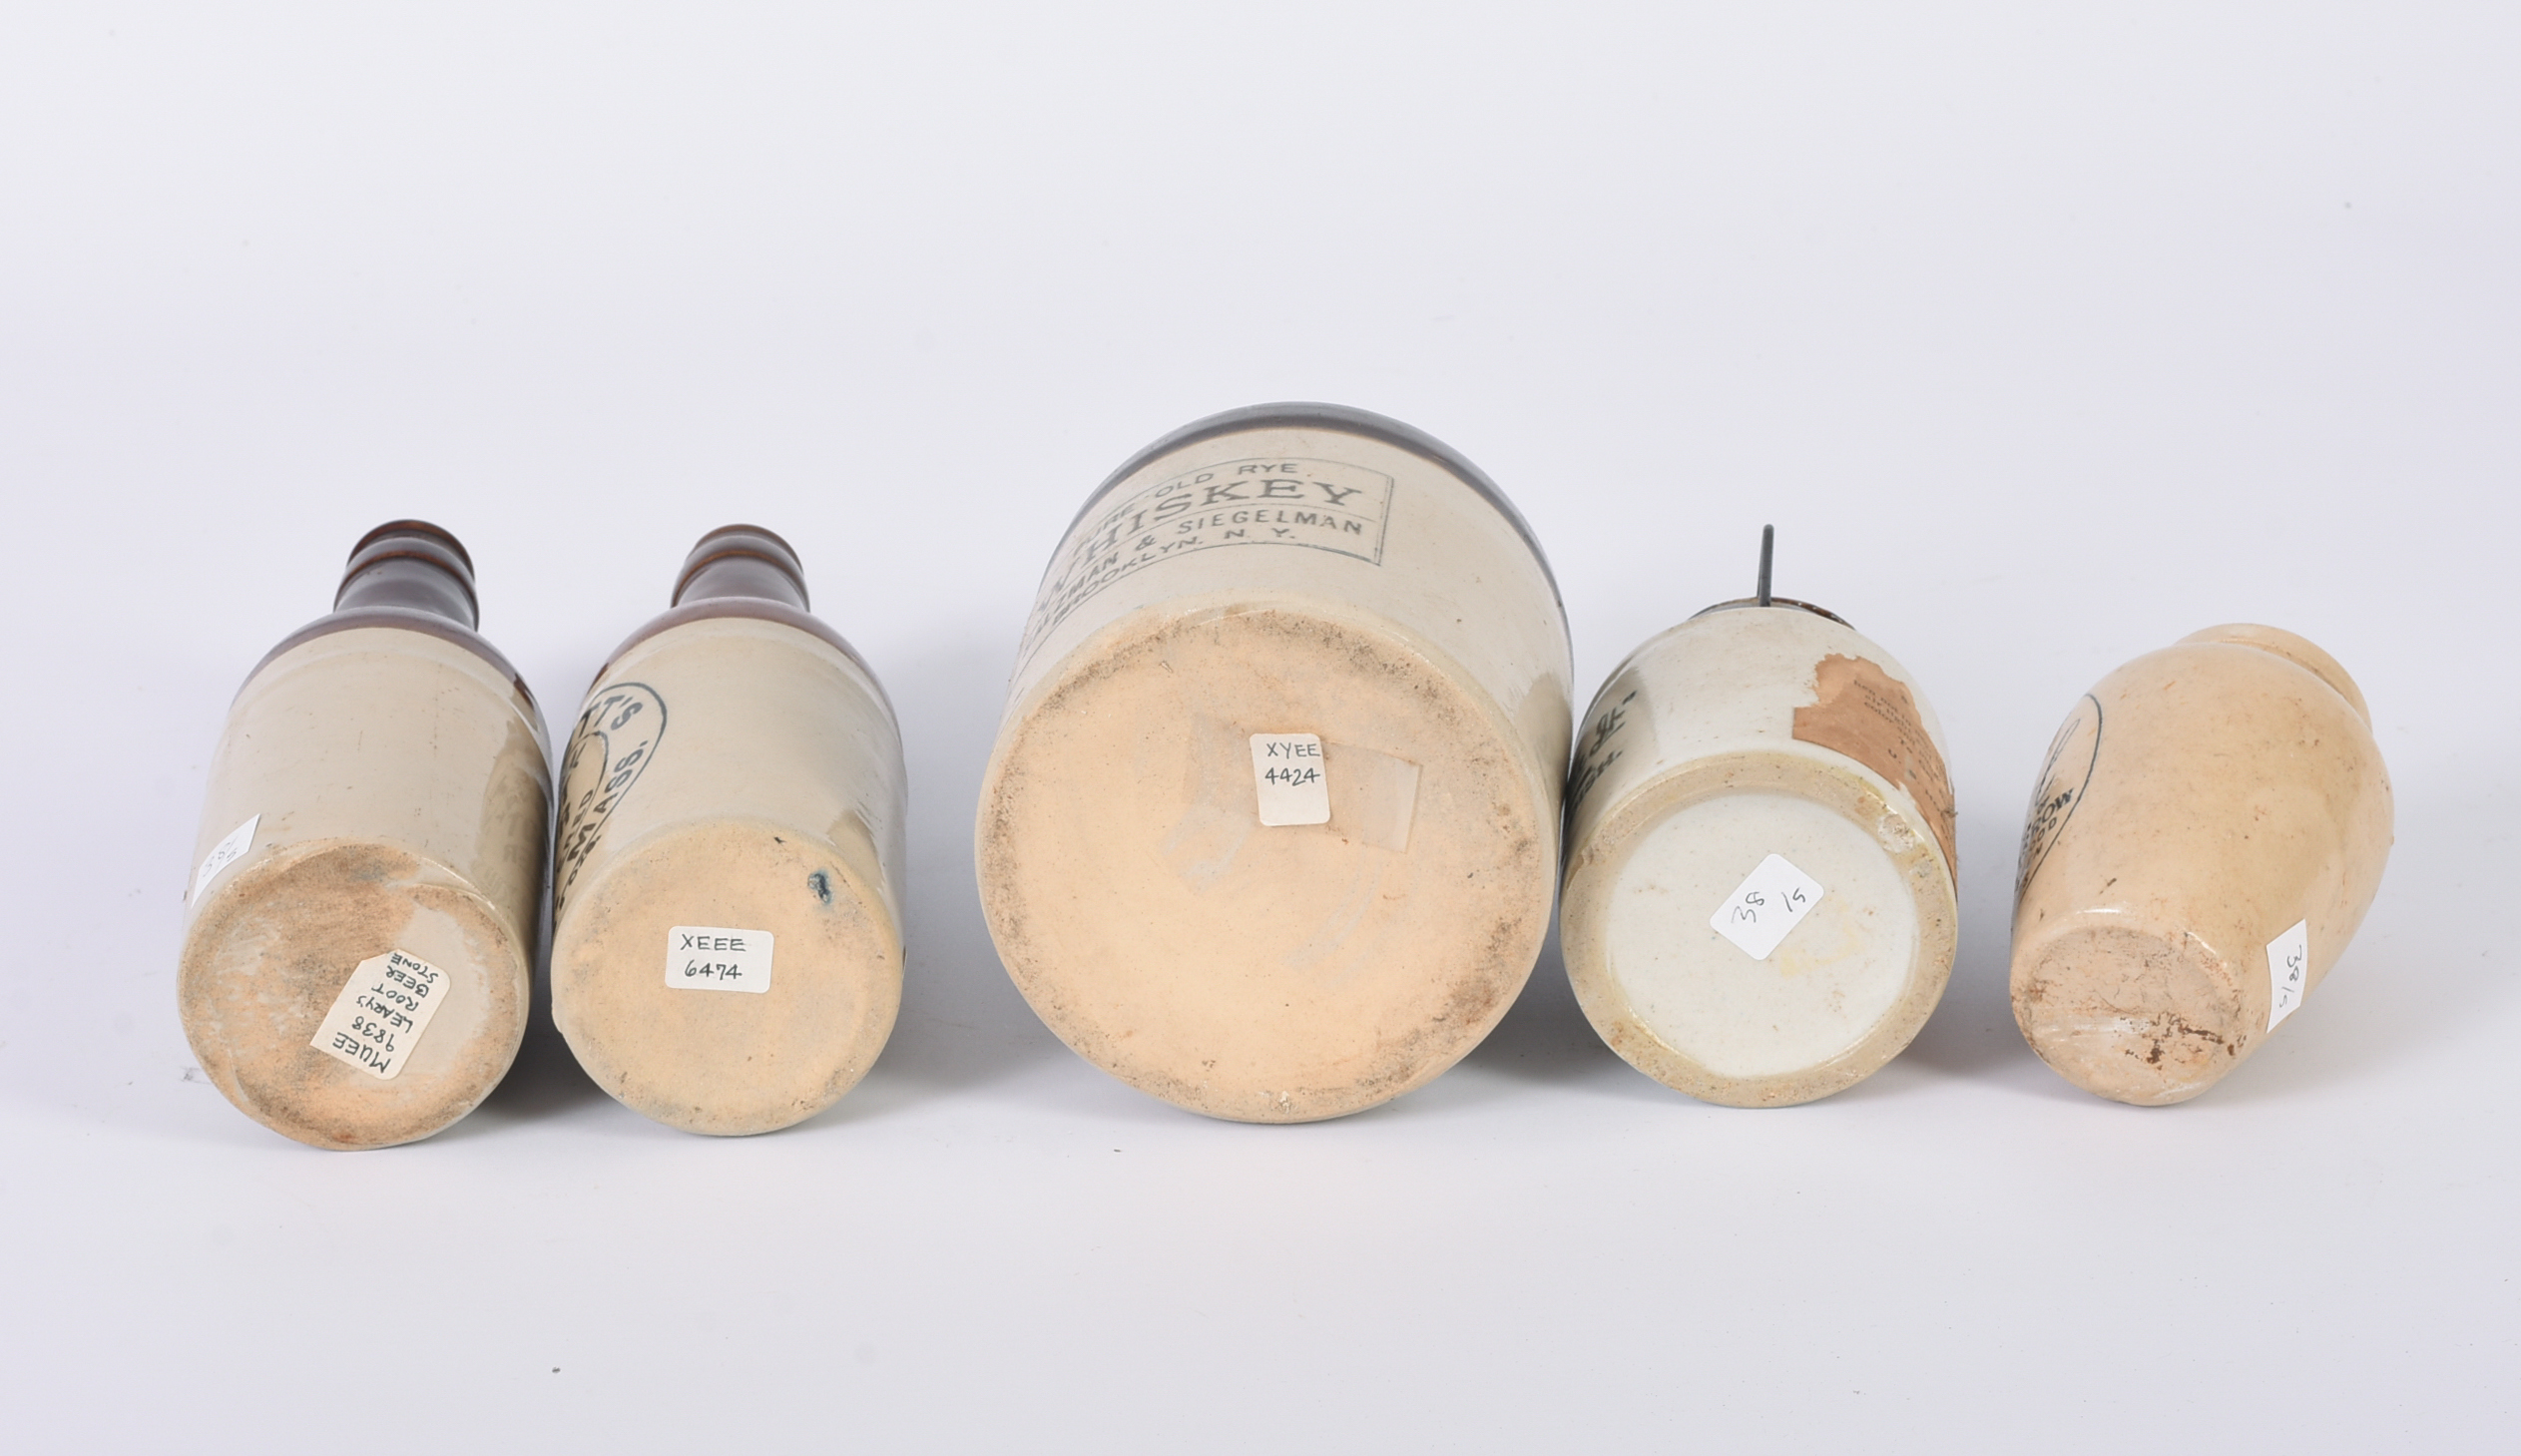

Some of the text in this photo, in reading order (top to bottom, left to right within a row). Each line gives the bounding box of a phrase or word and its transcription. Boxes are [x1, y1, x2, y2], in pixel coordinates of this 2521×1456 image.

[1073, 462, 1298, 559] PURE OLD RYE
[1038, 478, 1363, 612] WHISKEY
[1135, 534, 1157, 551] &
[1178, 509, 1363, 536] SIEGELMAN
[1270, 527, 1296, 540] Y.
[1265, 740, 1321, 760] XYEE
[1264, 766, 1321, 787] 4424
[680, 933, 747, 952] XEEE
[385, 965, 430, 998] BEER
[390, 952, 439, 984] STONE
[684, 959, 743, 981] 6474
[370, 982, 419, 1012] ROOT
[351, 1016, 395, 1053] 9838
[332, 1031, 391, 1075] MUEE
